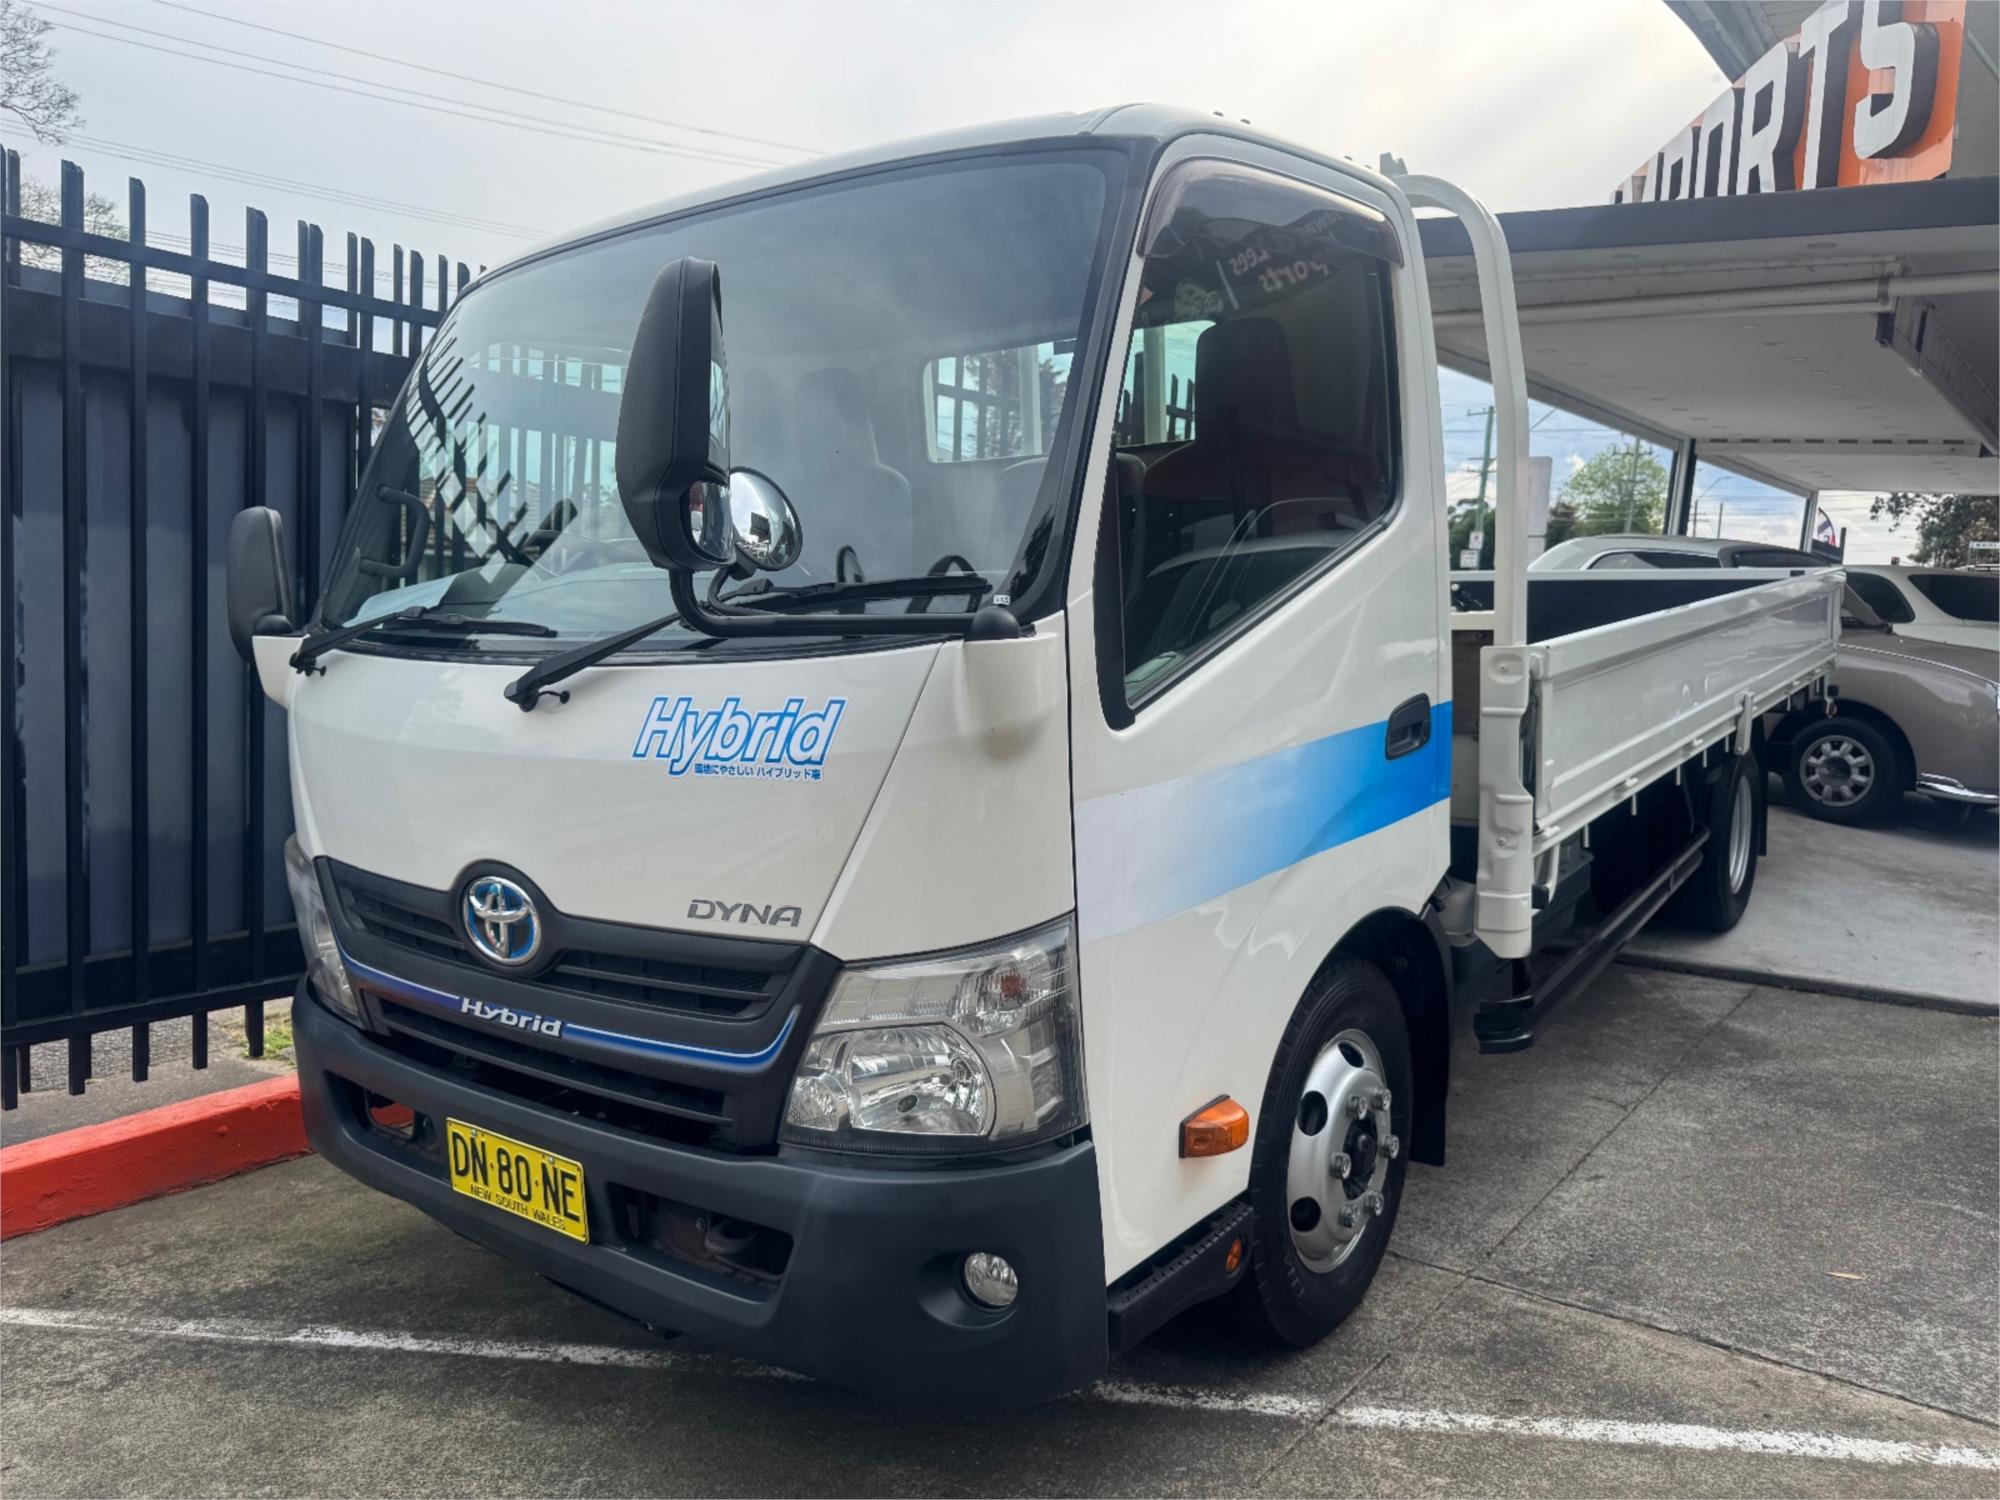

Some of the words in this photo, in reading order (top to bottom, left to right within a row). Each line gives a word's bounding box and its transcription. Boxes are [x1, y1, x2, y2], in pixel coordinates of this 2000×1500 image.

[1609, 0, 1916, 204] PORTS
[632, 697, 846, 775] Hybrid
[687, 899, 802, 927] DYNA
[460, 997, 562, 1037] Hybrid
[452, 1131, 489, 1187] DN
[541, 1162, 580, 1223] NE
[470, 1184, 492, 1202] NEW
[495, 1193, 529, 1215] SOUTH
[533, 1207, 567, 1231] WALES
